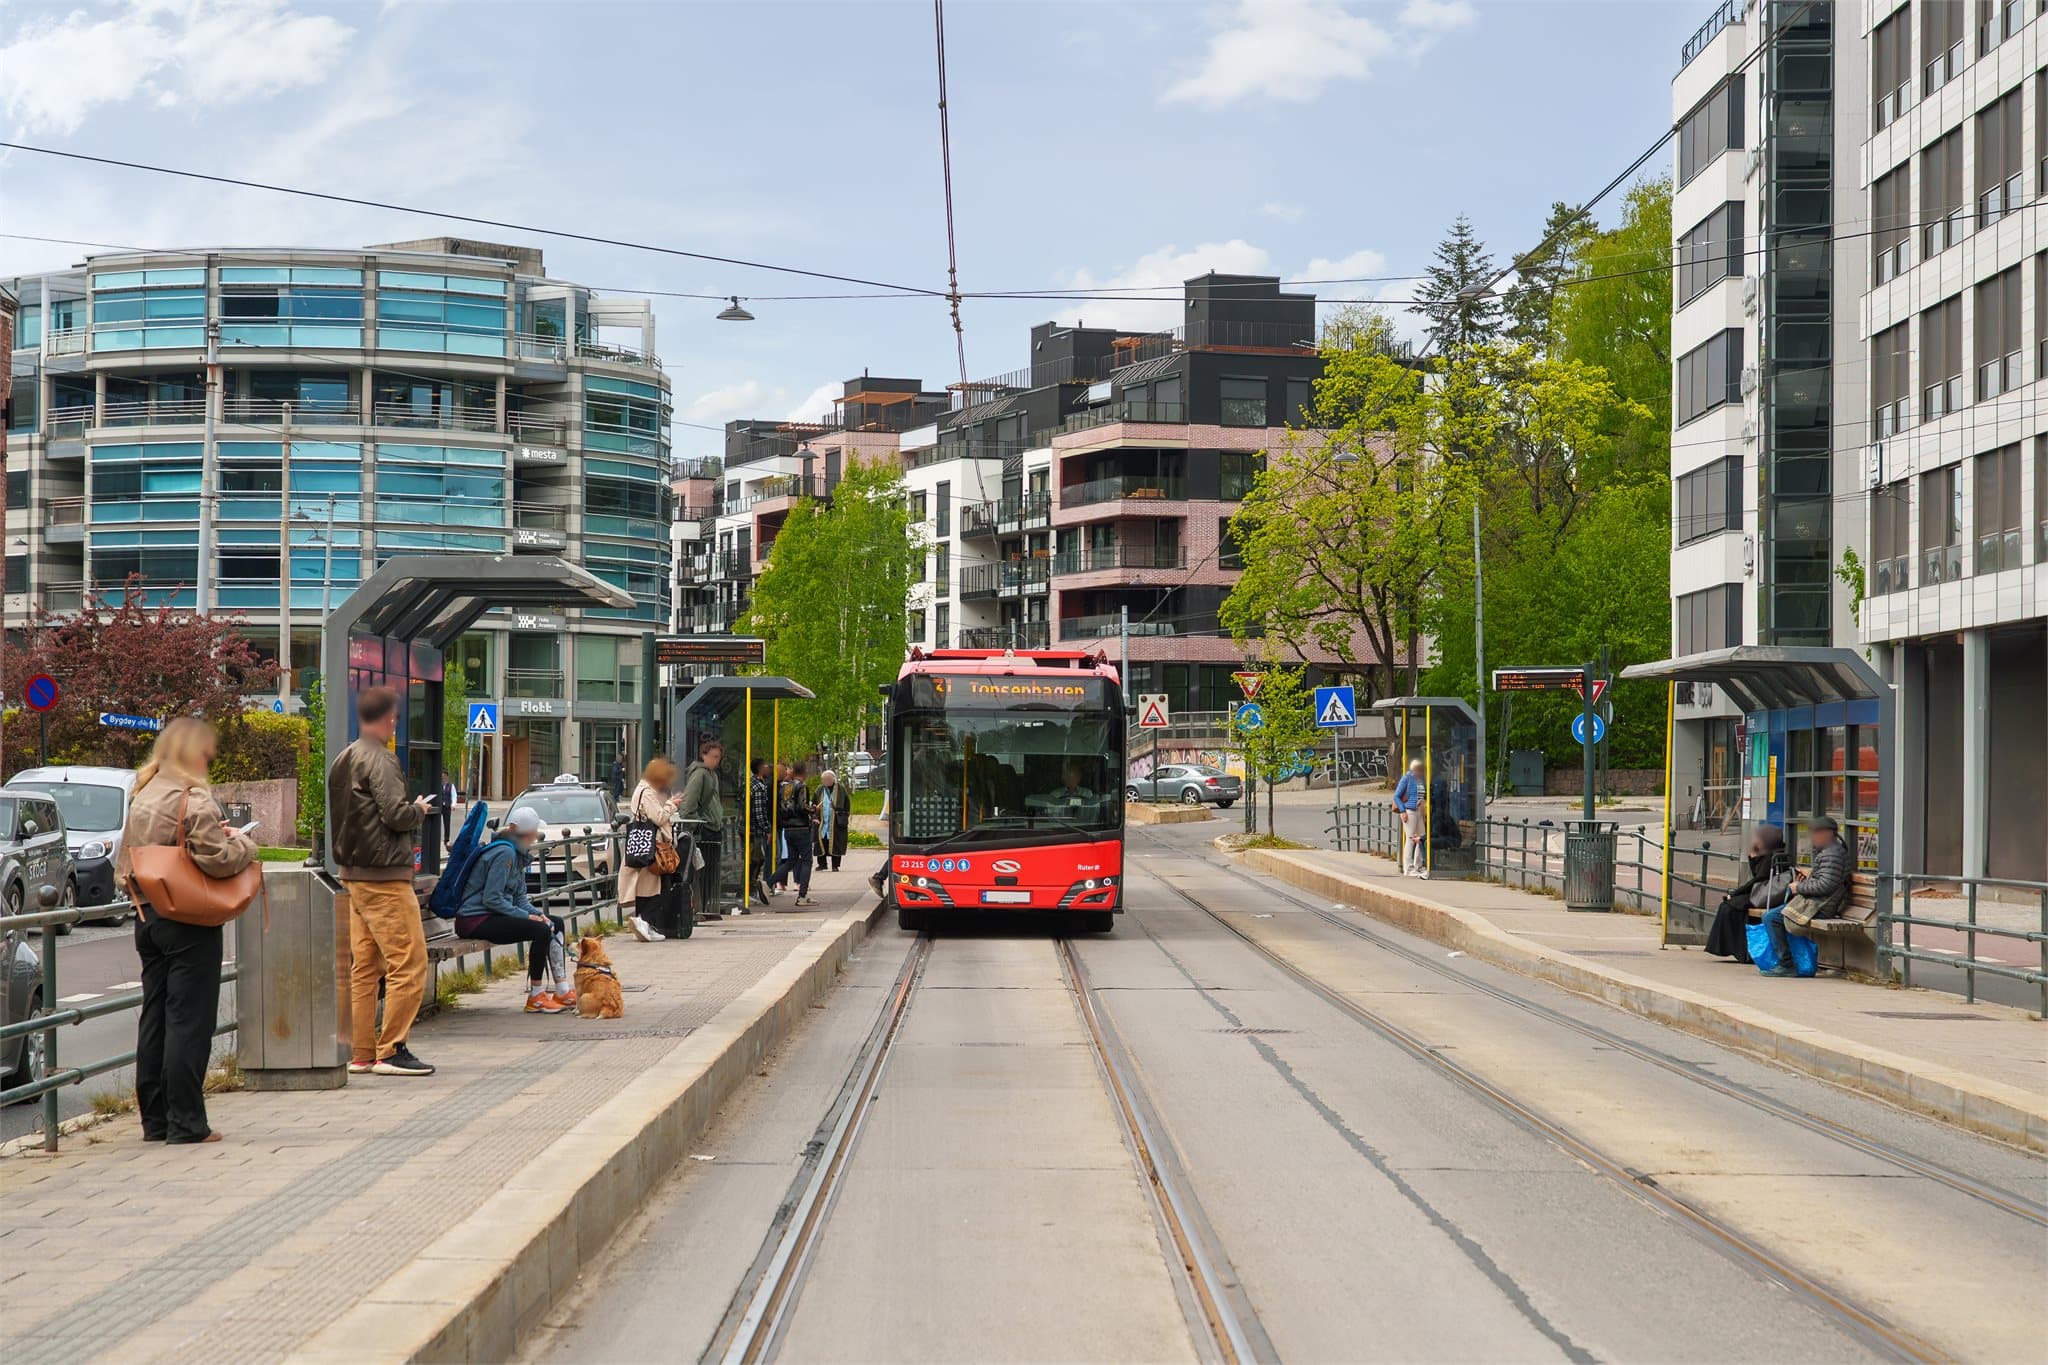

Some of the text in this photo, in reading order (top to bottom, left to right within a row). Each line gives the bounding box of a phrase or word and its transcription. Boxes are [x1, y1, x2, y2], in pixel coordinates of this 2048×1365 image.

[530, 449, 557, 460] mesta
[521, 701, 552, 713] Flokk
[109, 715, 137, 728] Bygdøy
[901, 861, 924, 869] 23 215
